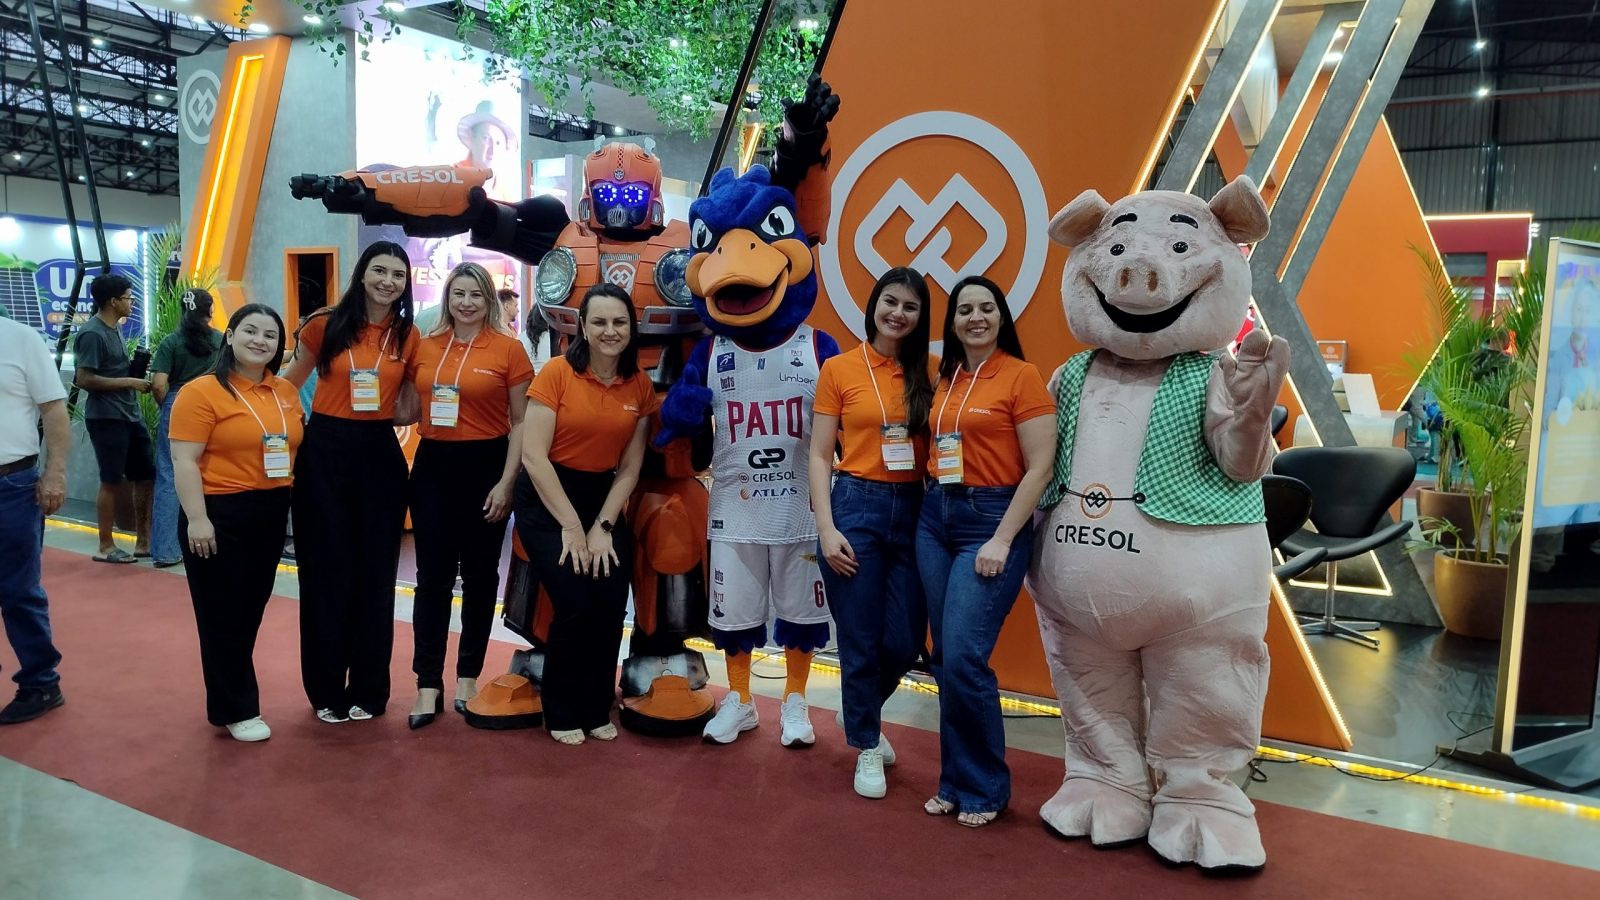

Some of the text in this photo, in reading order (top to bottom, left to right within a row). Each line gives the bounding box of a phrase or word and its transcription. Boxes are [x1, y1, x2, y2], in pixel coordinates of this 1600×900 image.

[376, 169, 464, 184] CRESOL
[726, 395, 804, 445] PATO
[752, 470, 797, 483] CRESOL
[752, 486, 798, 497] ATLAS
[1055, 524, 1141, 554] CRESOL
[813, 580, 825, 608] 6
